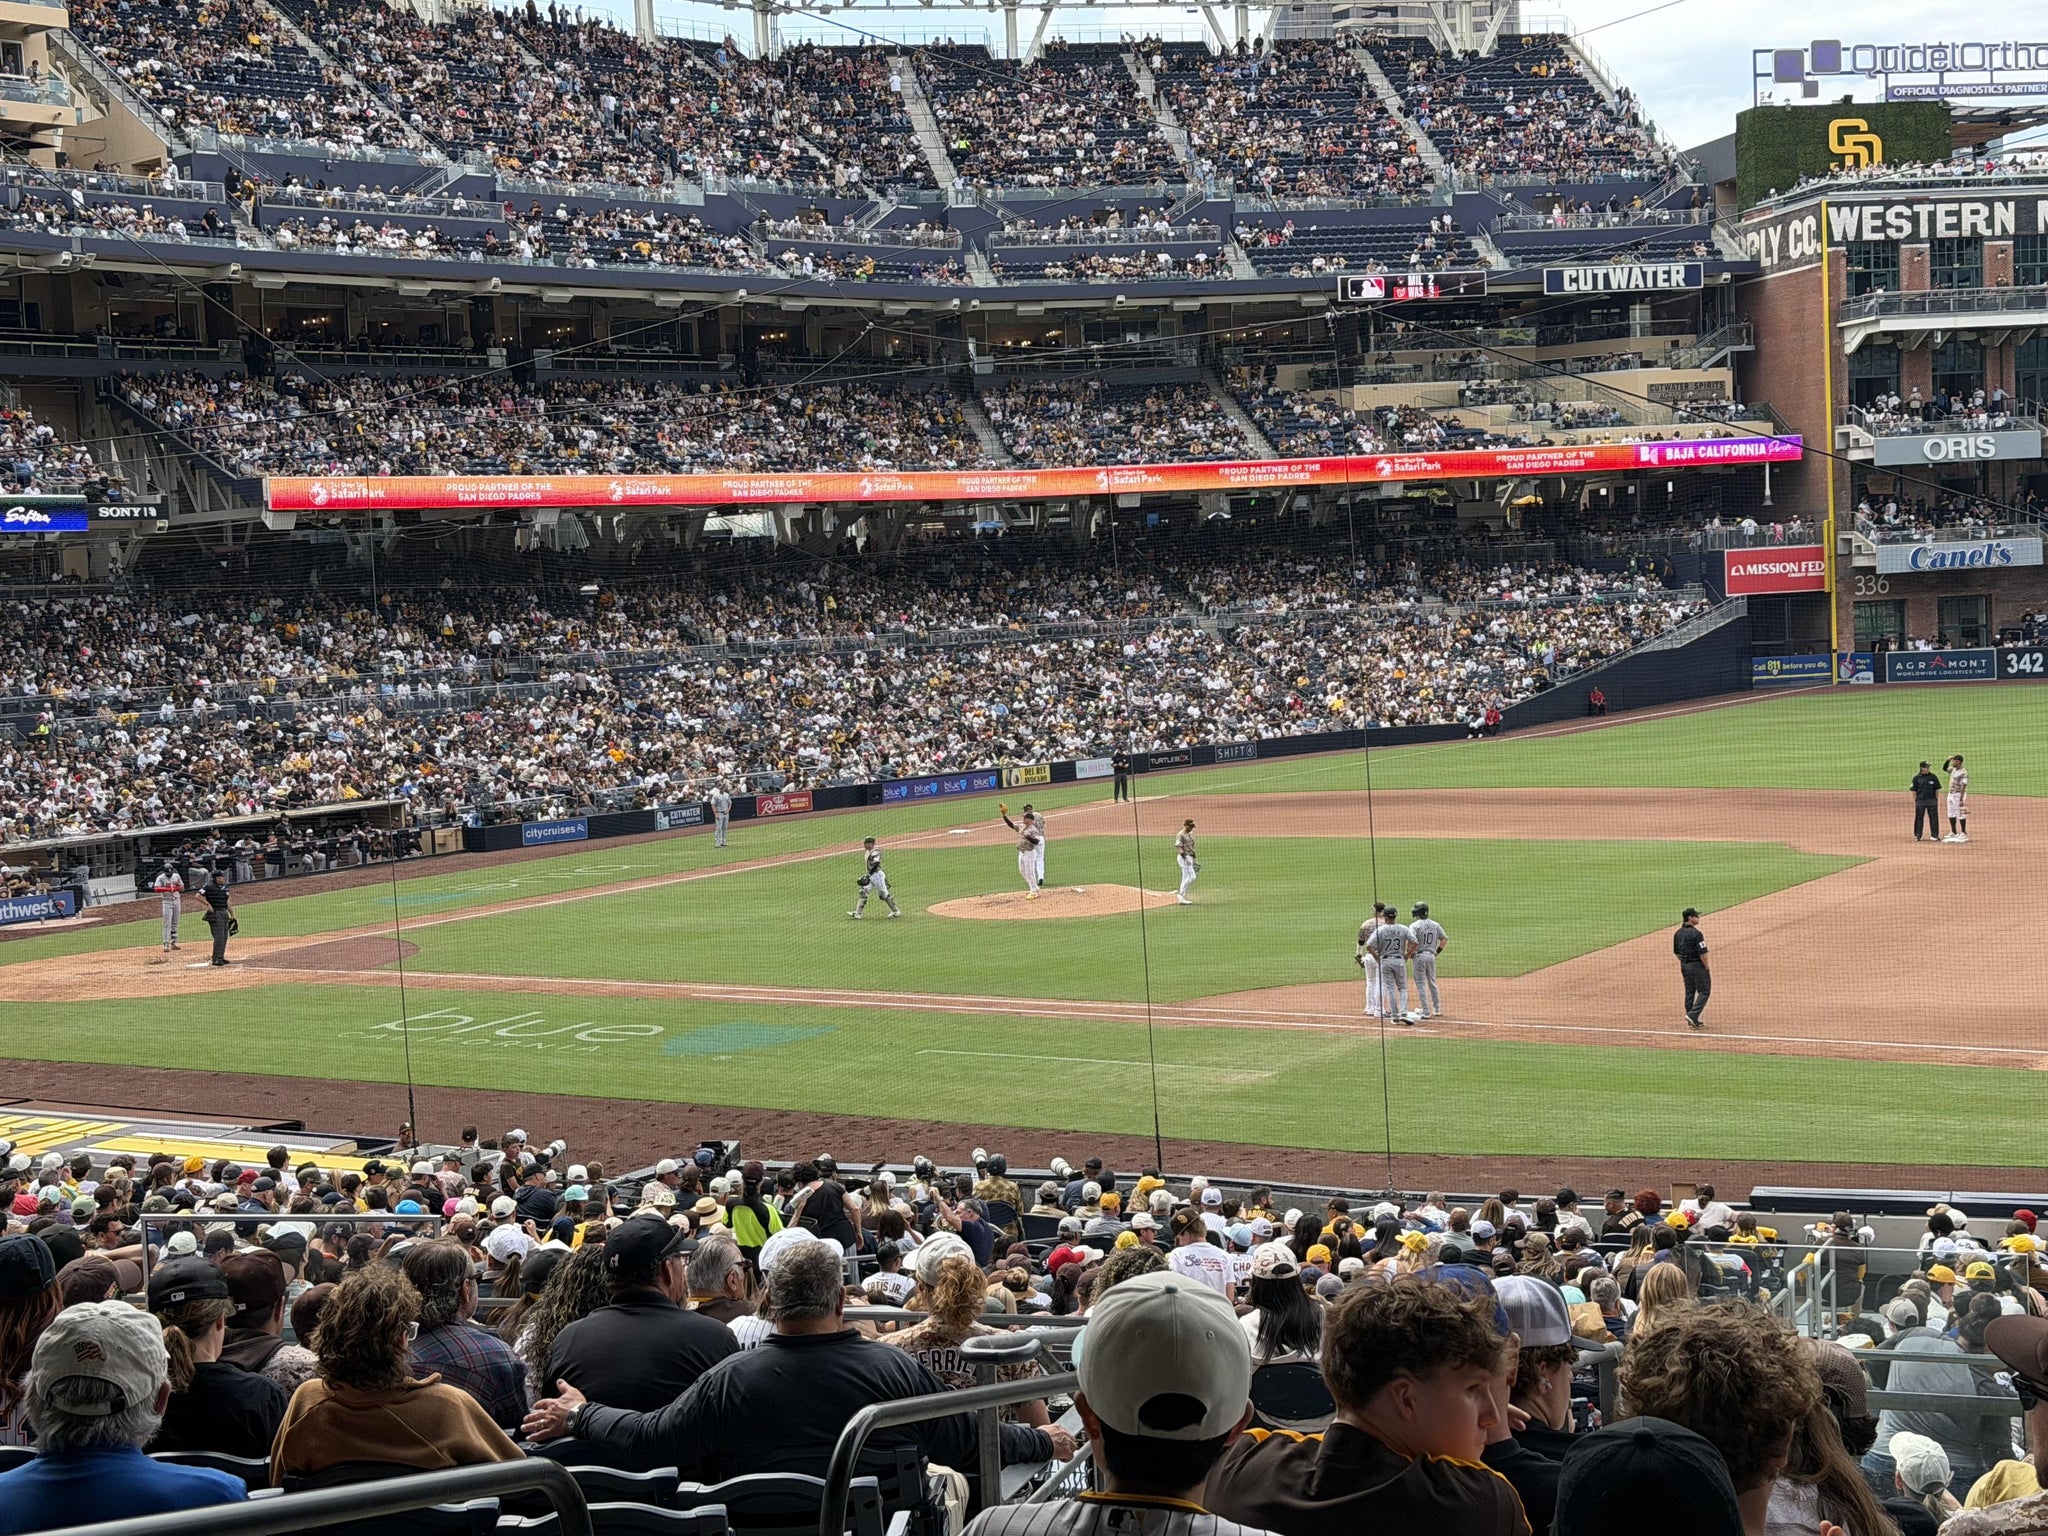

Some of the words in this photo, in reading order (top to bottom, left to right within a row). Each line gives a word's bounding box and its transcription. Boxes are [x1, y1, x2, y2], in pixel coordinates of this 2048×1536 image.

[1851, 42, 2048, 79] QuidelOrtho
[1893, 86, 1938, 97] OFFICIAL
[1939, 84, 2003, 96] DIAGNOSTICS
[2004, 83, 2048, 94] PARTNER
[1827, 201, 2015, 242] WESTERN
[1789, 215, 1822, 259] CO.
[1407, 275, 1424, 286] MIL
[1428, 274, 1434, 286] 2
[1563, 265, 1686, 292] CUTWATER
[1407, 286, 1424, 298] WAS
[1649, 382, 1689, 392] CUTWATER
[1694, 380, 1724, 390] SPIRITS
[1666, 447, 1695, 460] BAJA
[1698, 443, 1766, 458] CALIFORNIA
[1923, 435, 1996, 461] ORIS
[1496, 453, 1525, 463] PROUD
[1526, 452, 1564, 462] PARTNER
[1566, 451, 1577, 460] OF
[1579, 450, 1595, 459] THE
[1219, 467, 1248, 475] PROUD
[1250, 465, 1288, 474] PARTNER
[1290, 464, 1302, 472] OF
[1394, 462, 1420, 472] Safari
[1421, 460, 1442, 471] Park
[1506, 461, 1524, 470] SAN
[1525, 460, 1551, 469] DIEGO
[1553, 459, 1585, 468] PADRES
[1113, 474, 1140, 485] Safari
[1142, 473, 1163, 484] Park
[1230, 474, 1247, 483] SAN
[1249, 473, 1276, 482] DIEGO
[98, 507, 141, 517] SONY
[1908, 542, 2013, 571] Canel's
[1746, 562, 1798, 575] MISSION
[1801, 560, 1825, 572] FED
[1854, 575, 1889, 596] 336
[1767, 660, 1781, 671] 811
[1895, 654, 1988, 669] AGRAMONT
[2006, 652, 2044, 674] 342
[1024, 767, 1035, 775] DEL
[914, 784, 930, 793] blue
[944, 781, 960, 790] blue
[973, 778, 989, 787] blue
[884, 788, 900, 797] blue
[669, 807, 701, 820] CUTWATER
[761, 800, 789, 814] Roma
[525, 823, 576, 838] citycruises
[1384, 938, 1401, 951] 73
[1423, 932, 1434, 945] 10
[368, 1007, 665, 1042] blue
[337, 1030, 601, 1053] CALIFORNIA
